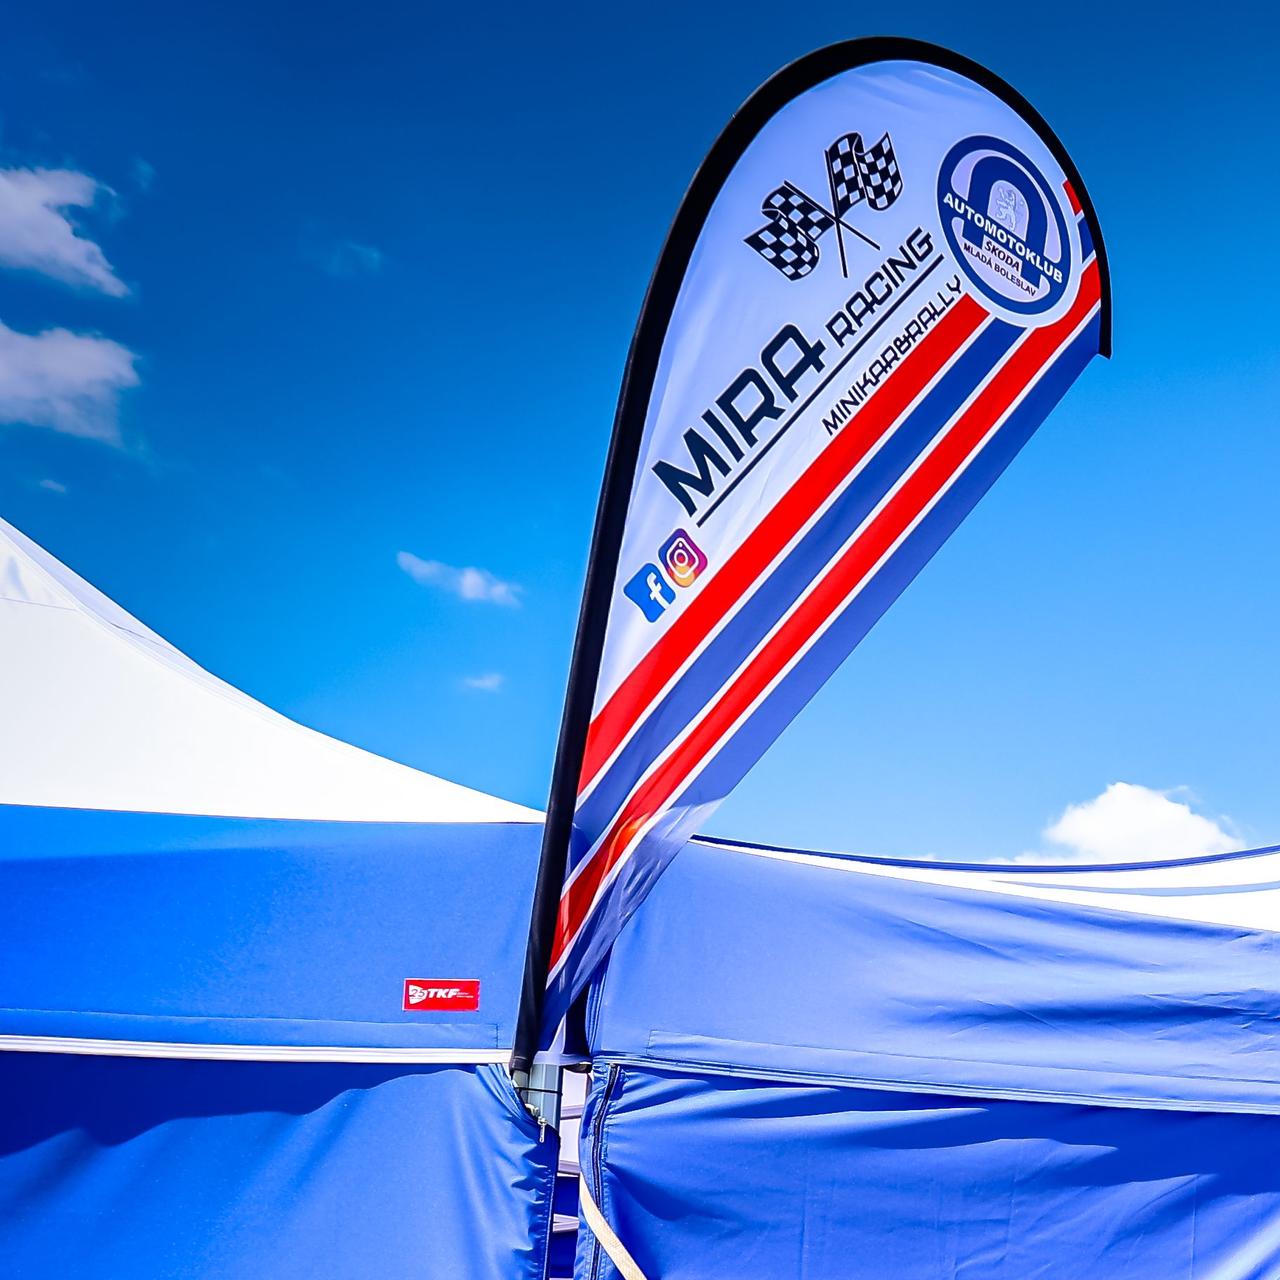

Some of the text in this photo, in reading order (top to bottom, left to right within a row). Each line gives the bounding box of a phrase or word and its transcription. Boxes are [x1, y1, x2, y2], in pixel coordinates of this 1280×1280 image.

[943, 193, 1063, 283] AUTOMOTOKLUB
[985, 241, 1021, 272] ŠKODA
[994, 264, 1036, 296] BOLESLAV
[652, 227, 934, 517] MIRA RACING
[822, 274, 961, 436] MINIKAR&RALLY
[428, 988, 460, 999] TKF
